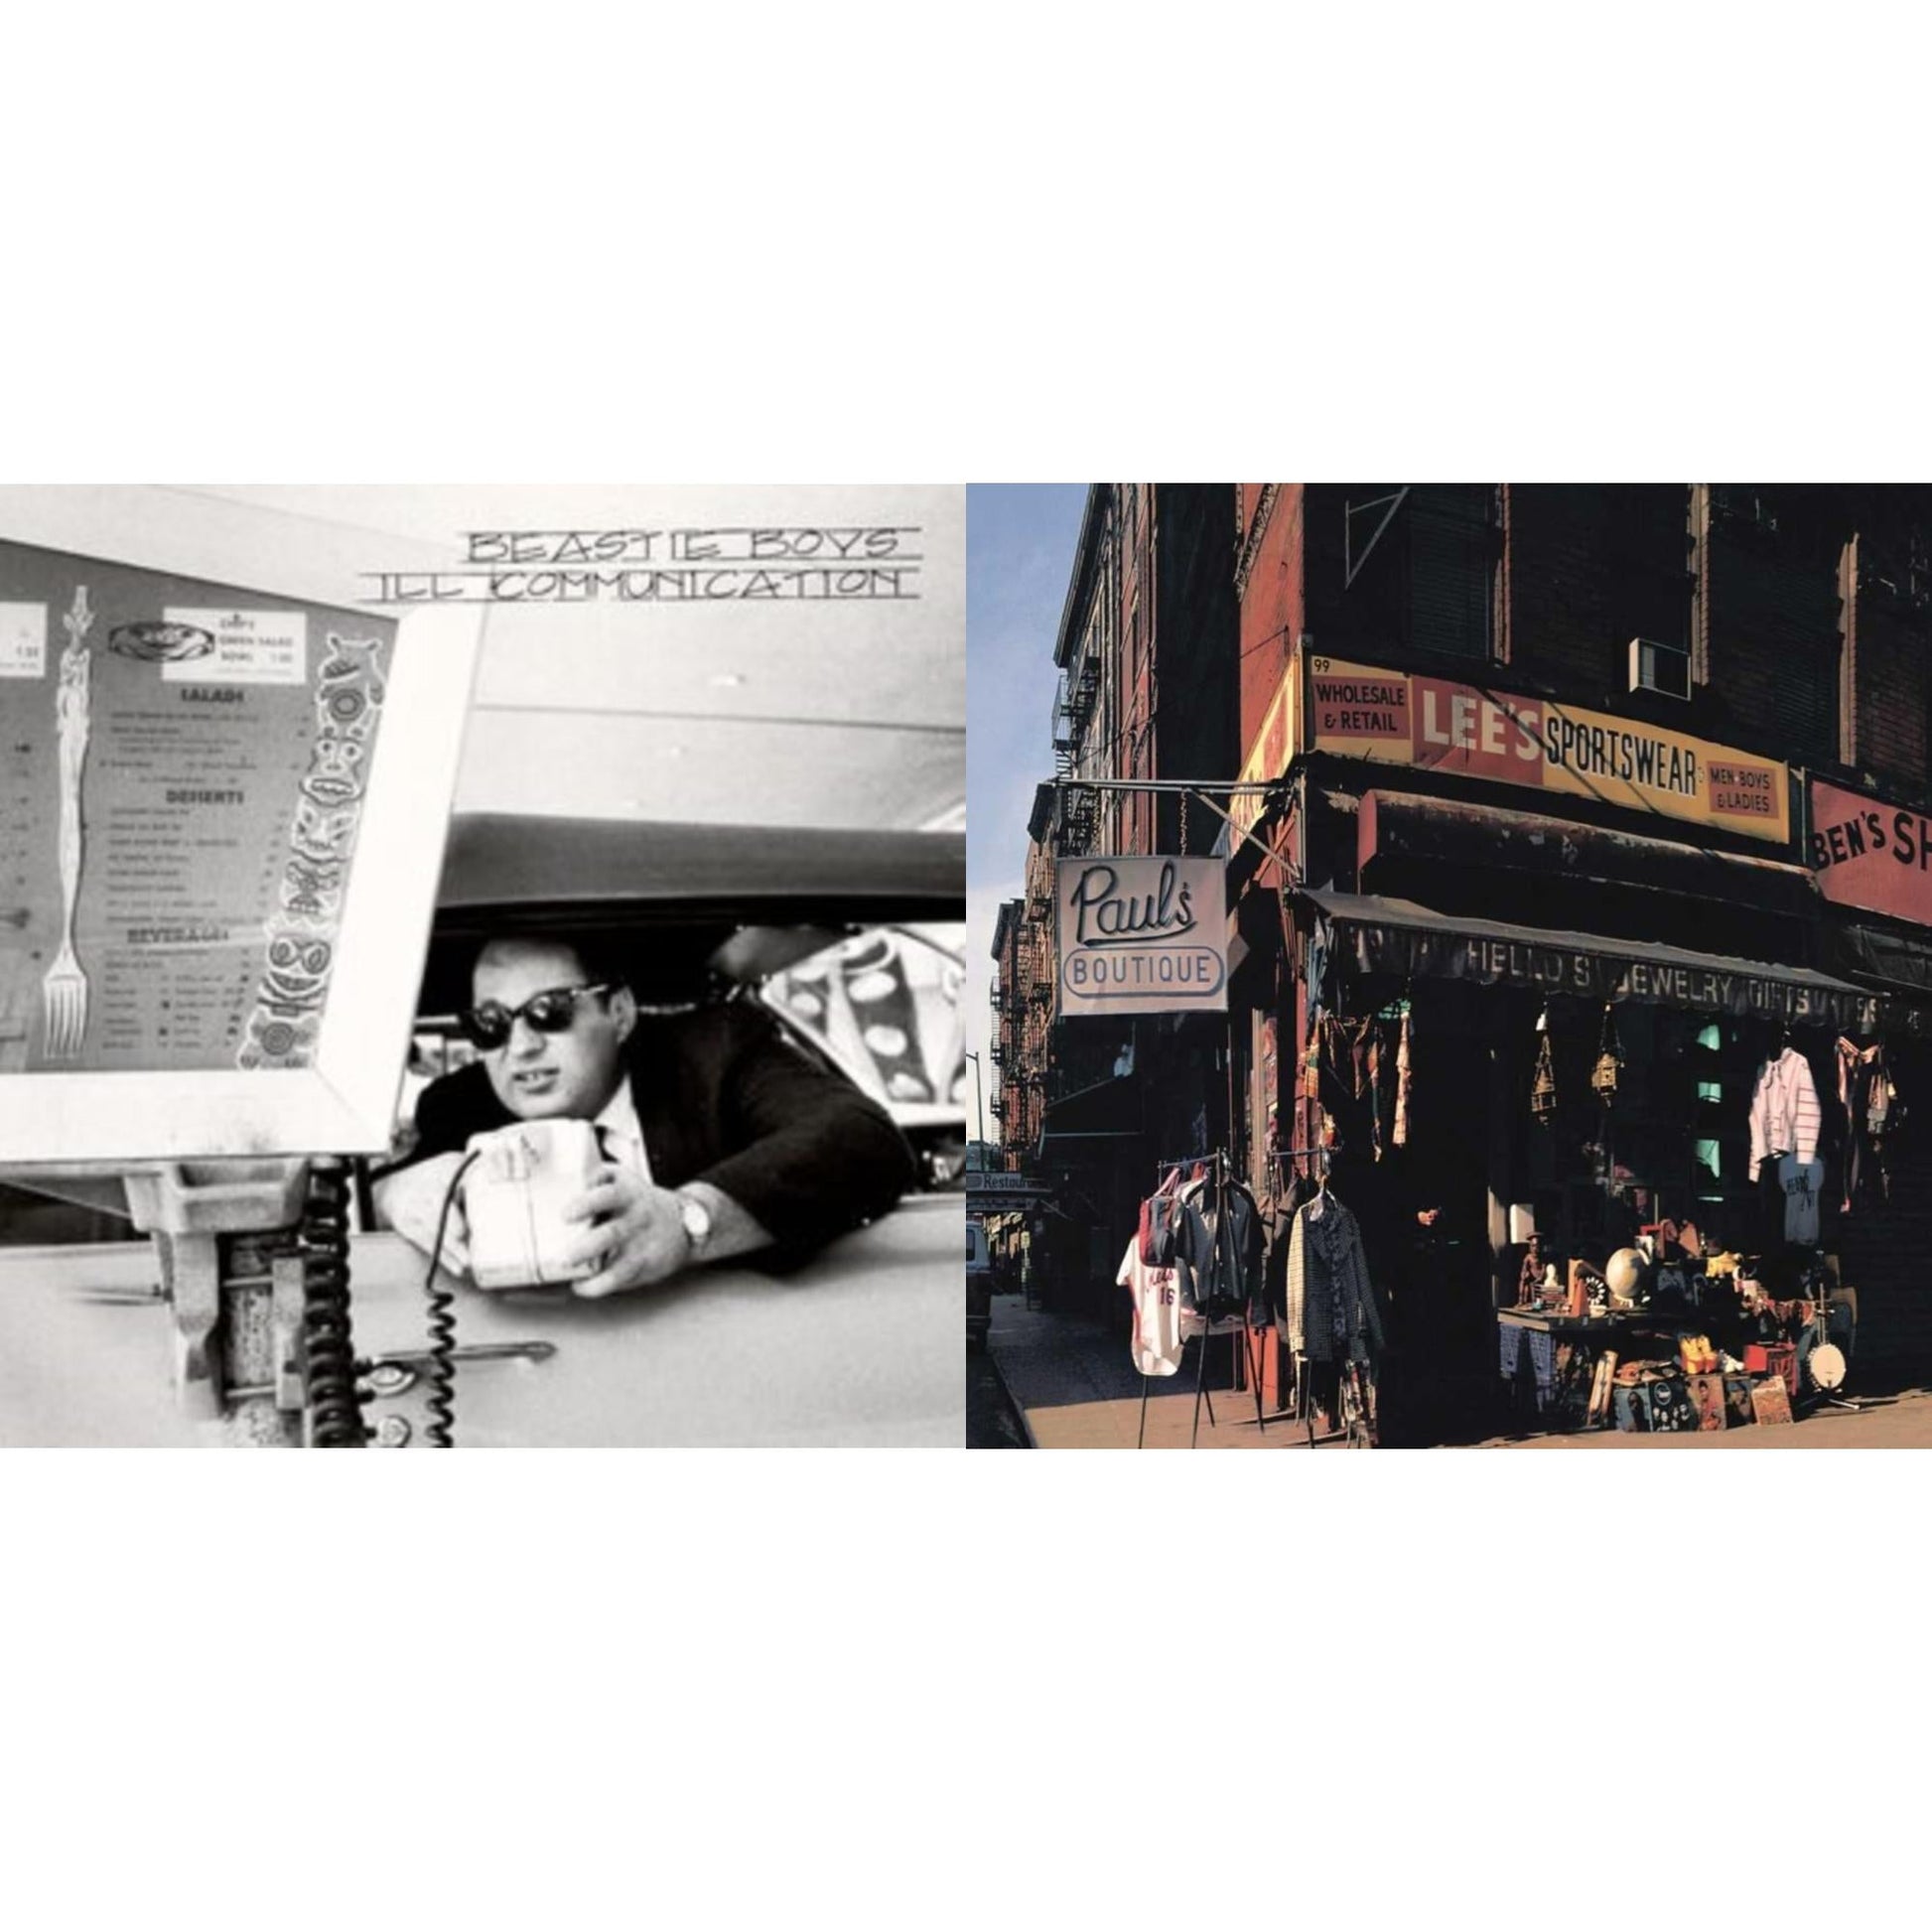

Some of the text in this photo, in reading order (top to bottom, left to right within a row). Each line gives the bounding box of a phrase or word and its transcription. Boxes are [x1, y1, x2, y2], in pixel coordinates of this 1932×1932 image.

[1313, 659, 1330, 673] 99
[1315, 683, 1405, 707] WHOLESALE
[1323, 711, 1398, 733] & RETAIL
[1423, 690, 1698, 797] LEE'S SPORTSWEAR
[1739, 770, 1770, 789] BOYS
[1727, 793, 1770, 812] LADIES
[1812, 810, 1886, 872] BEN'S
[1070, 860, 1196, 944] Paul's
[1073, 956, 1211, 985] BOUTIQUE
[1614, 963, 1732, 1004] JEWELRY
